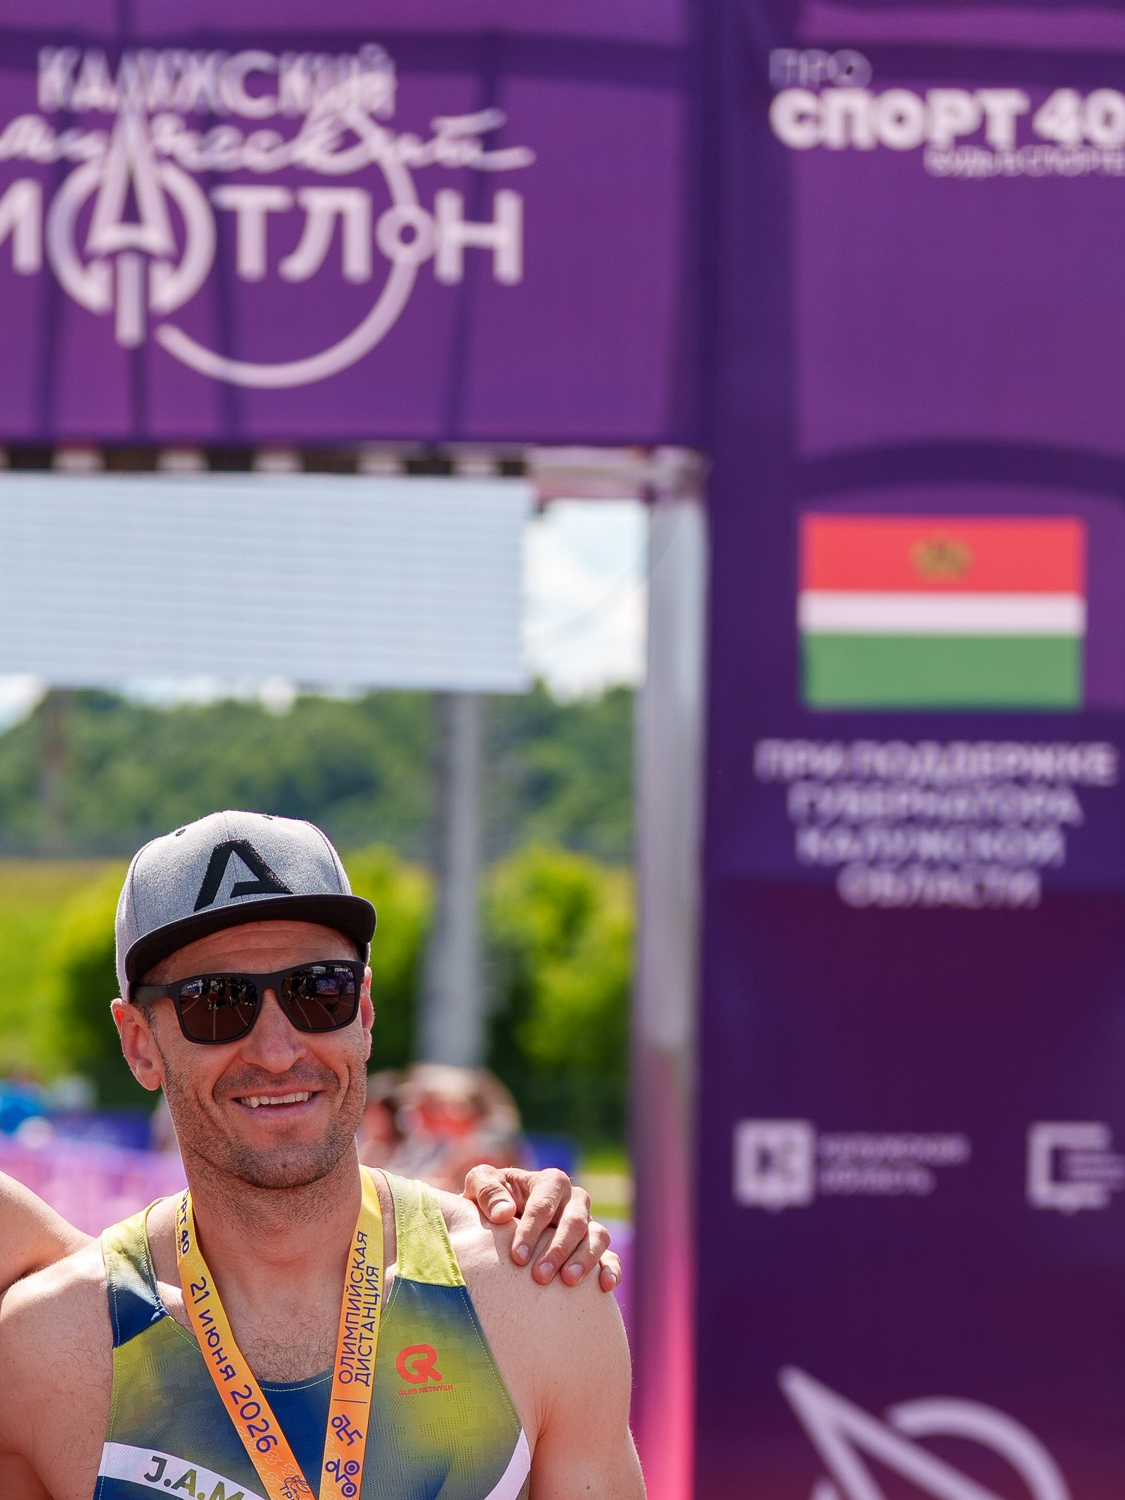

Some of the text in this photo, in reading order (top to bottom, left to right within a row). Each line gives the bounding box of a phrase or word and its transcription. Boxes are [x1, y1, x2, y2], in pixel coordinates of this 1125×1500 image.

[768, 87, 1125, 151] СПОРТ 40
[190, 1276, 279, 1454] 21 ИЮНЯ 2026
[338, 1231, 368, 1385] ОЛИМПИЙСКАЯ
[354, 1265, 380, 1387] ДИСТАНЦИЯ
